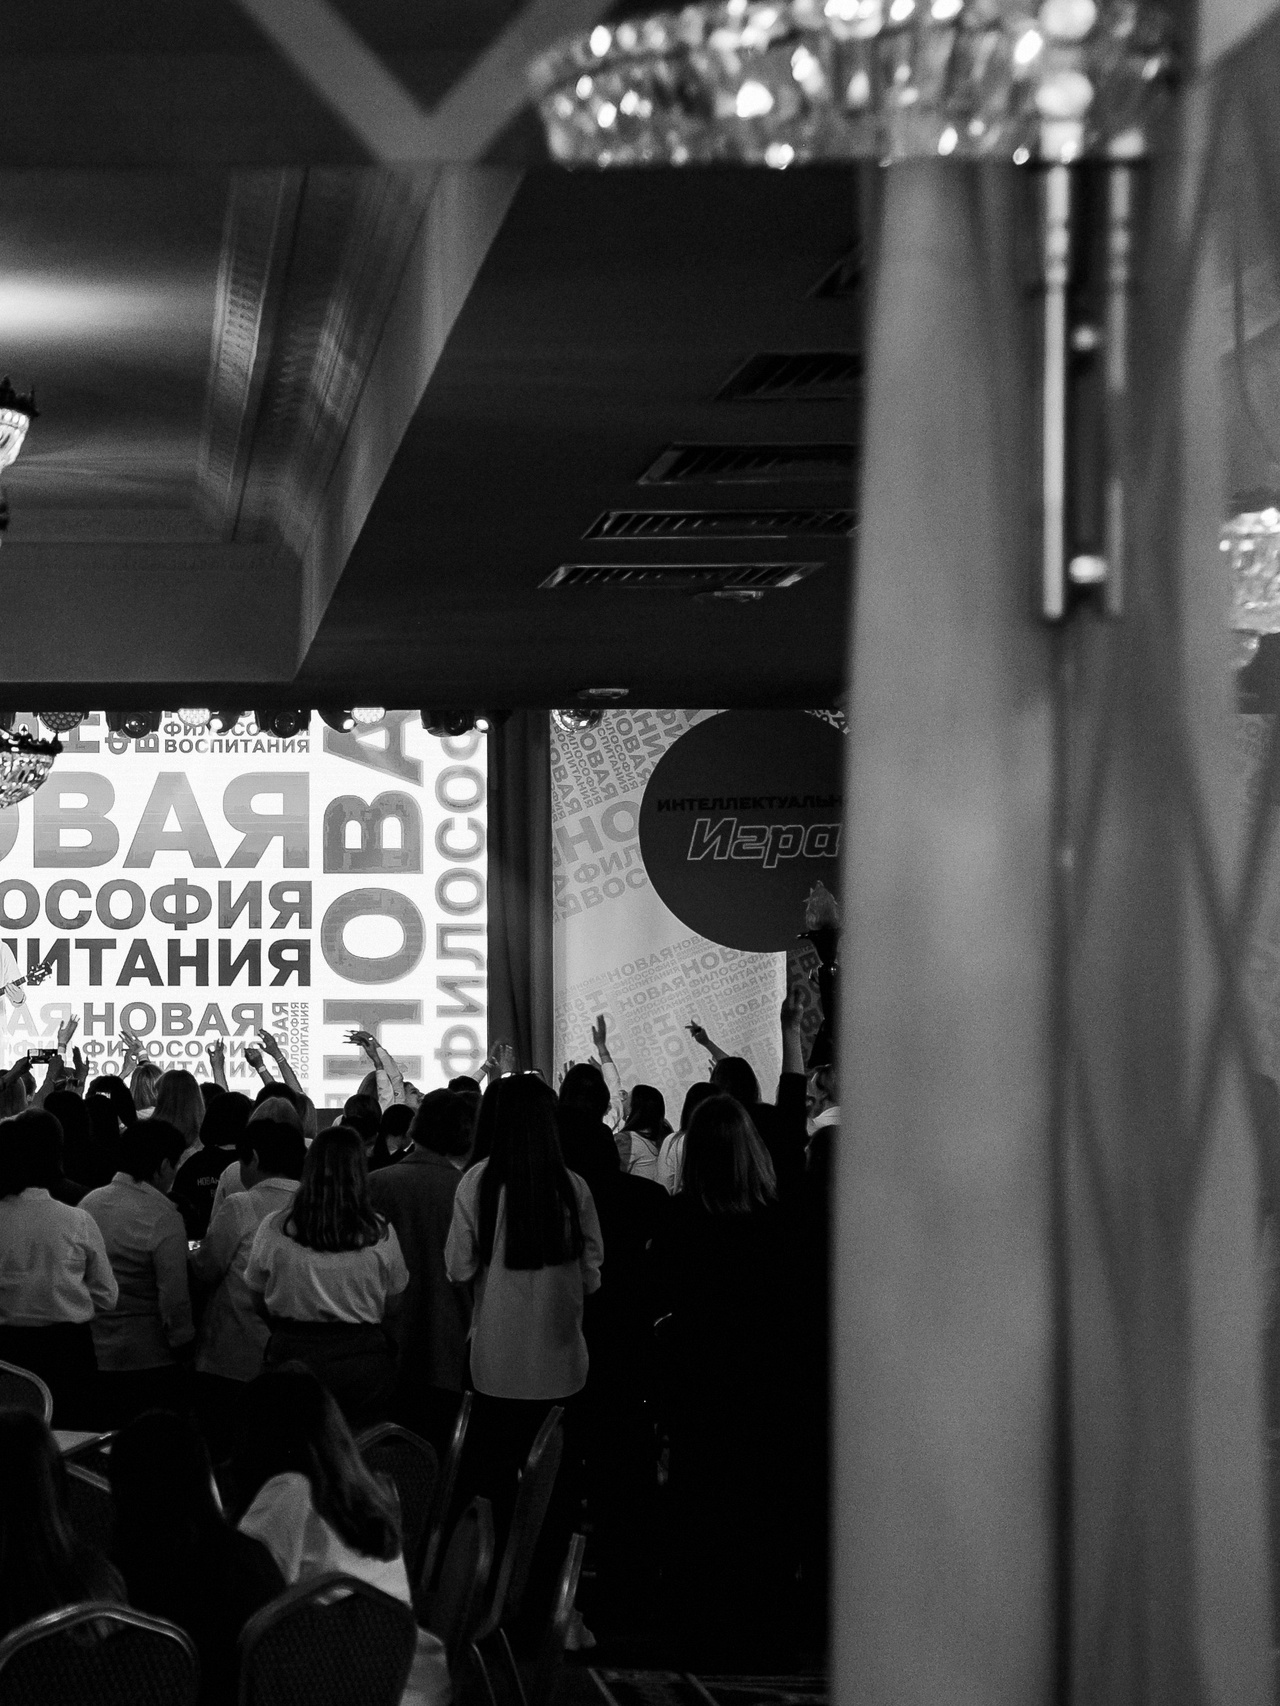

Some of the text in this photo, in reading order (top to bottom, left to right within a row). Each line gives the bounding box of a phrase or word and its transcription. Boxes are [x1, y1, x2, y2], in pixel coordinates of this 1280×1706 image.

[163, 721, 309, 739] ФИЛСО
[164, 738, 310, 753] ВОСПИТАНИЯ
[566, 730, 603, 805] ИЛОСОФИЯ
[578, 730, 619, 802] ОВАЯ
[596, 726, 630, 794] СПИТАНИЯ
[687, 817, 842, 868] Игра
[606, 946, 675, 983] НОВАЯ
[83, 1001, 264, 1037] НОВАЯ
[290, 1002, 300, 1076] ИЛОСОФИЯ
[300, 1002, 310, 1079] ВОСПИТАНИЯ
[82, 1039, 265, 1058] ФИОСОФИЯ
